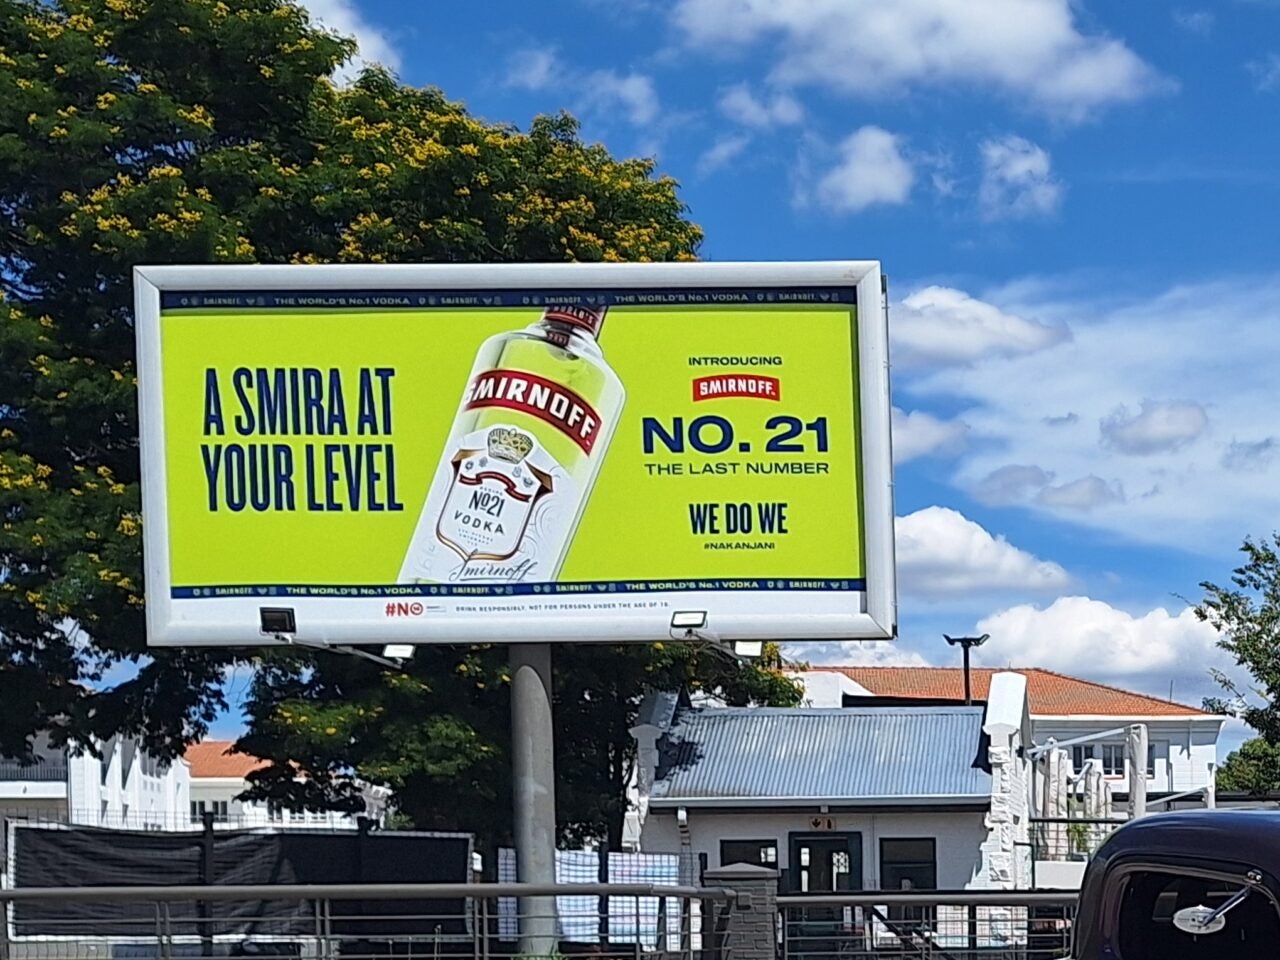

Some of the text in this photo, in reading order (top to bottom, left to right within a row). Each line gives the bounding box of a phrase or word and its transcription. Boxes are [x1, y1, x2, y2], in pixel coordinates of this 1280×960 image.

[298, 297, 346, 305] WORLD'S
[372, 297, 410, 305] VODKA
[638, 294, 686, 302] WORLD'S
[711, 293, 749, 301] VODKA
[688, 356, 783, 366] INTRODUCING
[203, 366, 396, 436] A SMIRA AT
[642, 415, 829, 454] NO. 21
[200, 442, 404, 512] YOUR LEVEL
[644, 462, 829, 475] THE LAST NUMBER
[454, 510, 506, 536] VODKA
[688, 502, 788, 535] WE DO WE
[704, 542, 775, 550] #NAKANJANI
[449, 548, 538, 582] Smirnoff
[286, 587, 307, 595] THE
[309, 587, 358, 595] WORLD'S
[360, 587, 382, 595] No.1
[384, 586, 422, 595] VODKA
[648, 582, 696, 590] WORLD'S
